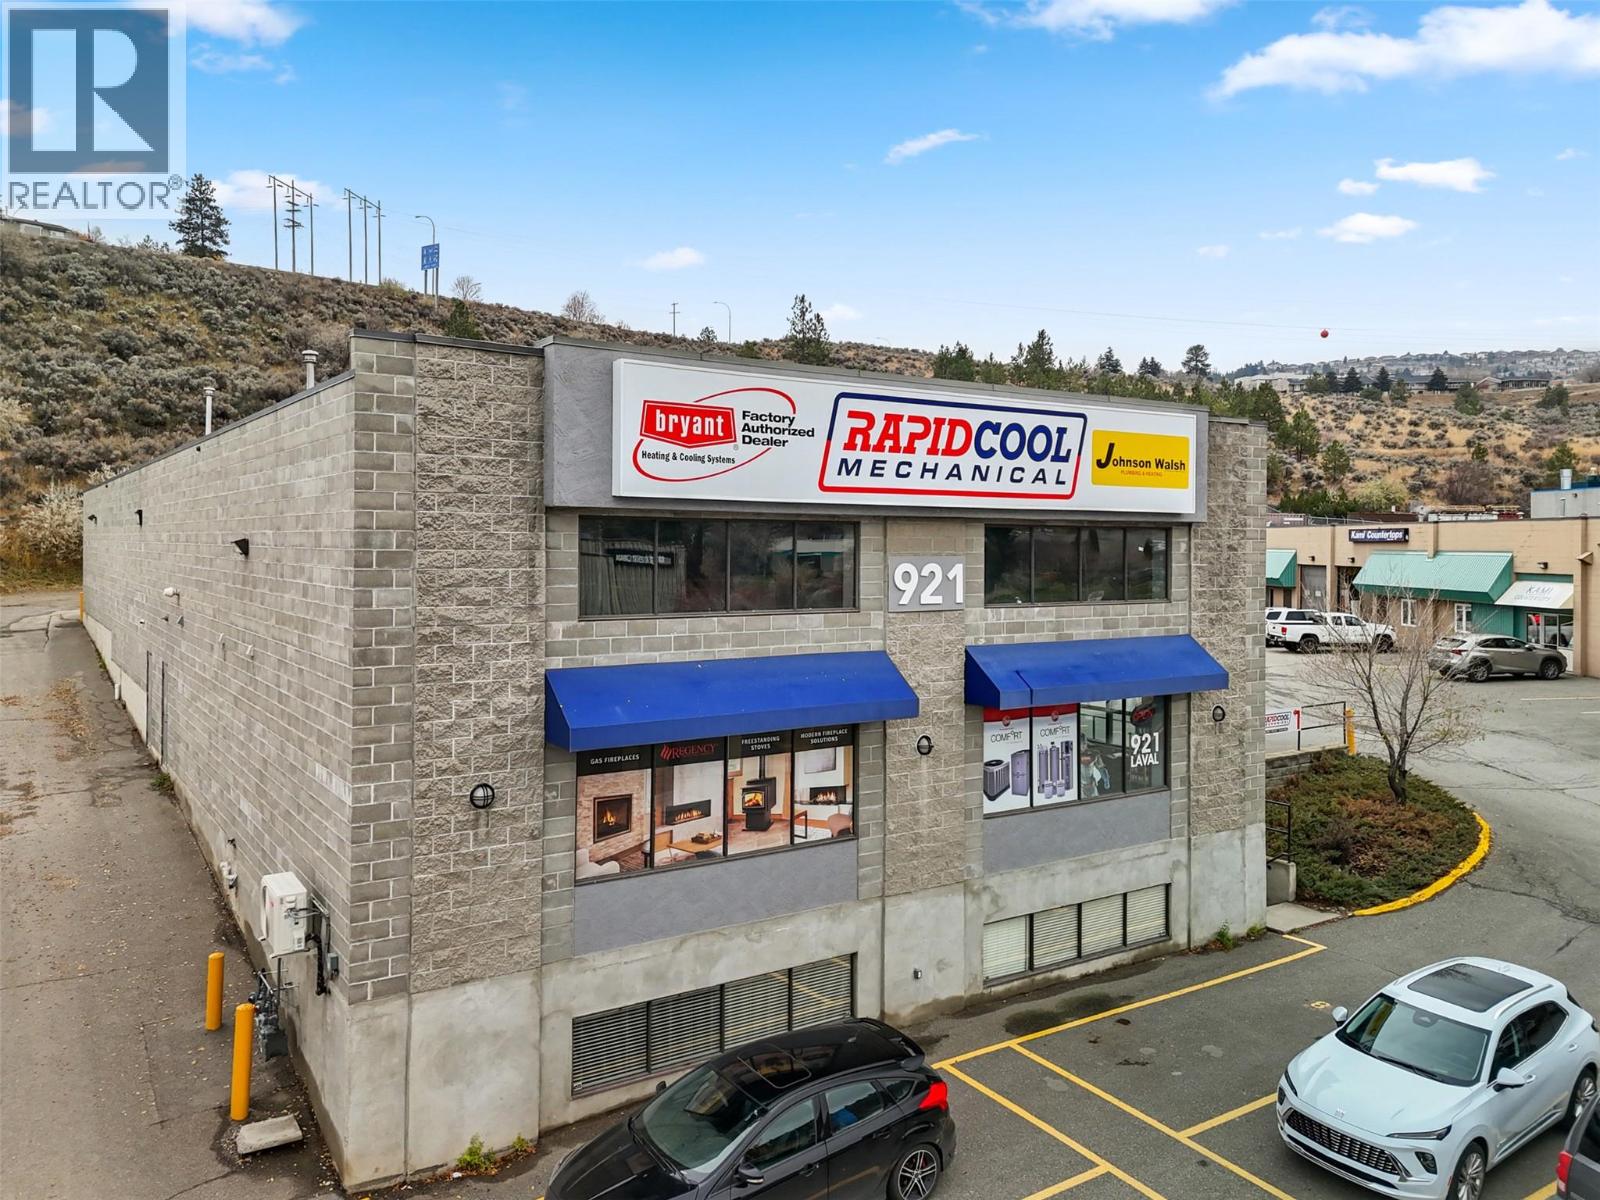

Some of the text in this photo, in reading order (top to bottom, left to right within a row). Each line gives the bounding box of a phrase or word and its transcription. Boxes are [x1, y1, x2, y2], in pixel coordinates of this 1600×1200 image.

[655, 409, 725, 438] bryant
[742, 410, 796, 427] Factory
[741, 423, 815, 437] Authorized
[742, 434, 789, 447] Dealer
[641, 450, 736, 464] Heating & Cooling Systems
[1096, 442, 1186, 471] Johnson Walsh
[837, 458, 1067, 485] MECHANICAL
[1366, 530, 1403, 540] Countertops
[893, 562, 964, 605] 921
[822, 728, 848, 736] FIREPLACE
[741, 735, 780, 745] FREESTANDING
[751, 743, 771, 751] STOVES
[810, 736, 839, 744] SOLUTIONS
[1130, 732, 1159, 755] 921
[672, 744, 716, 759] REGENCY
[590, 754, 640, 765] GAS FIREPLACES
[1130, 753, 1159, 768] LAVAL
